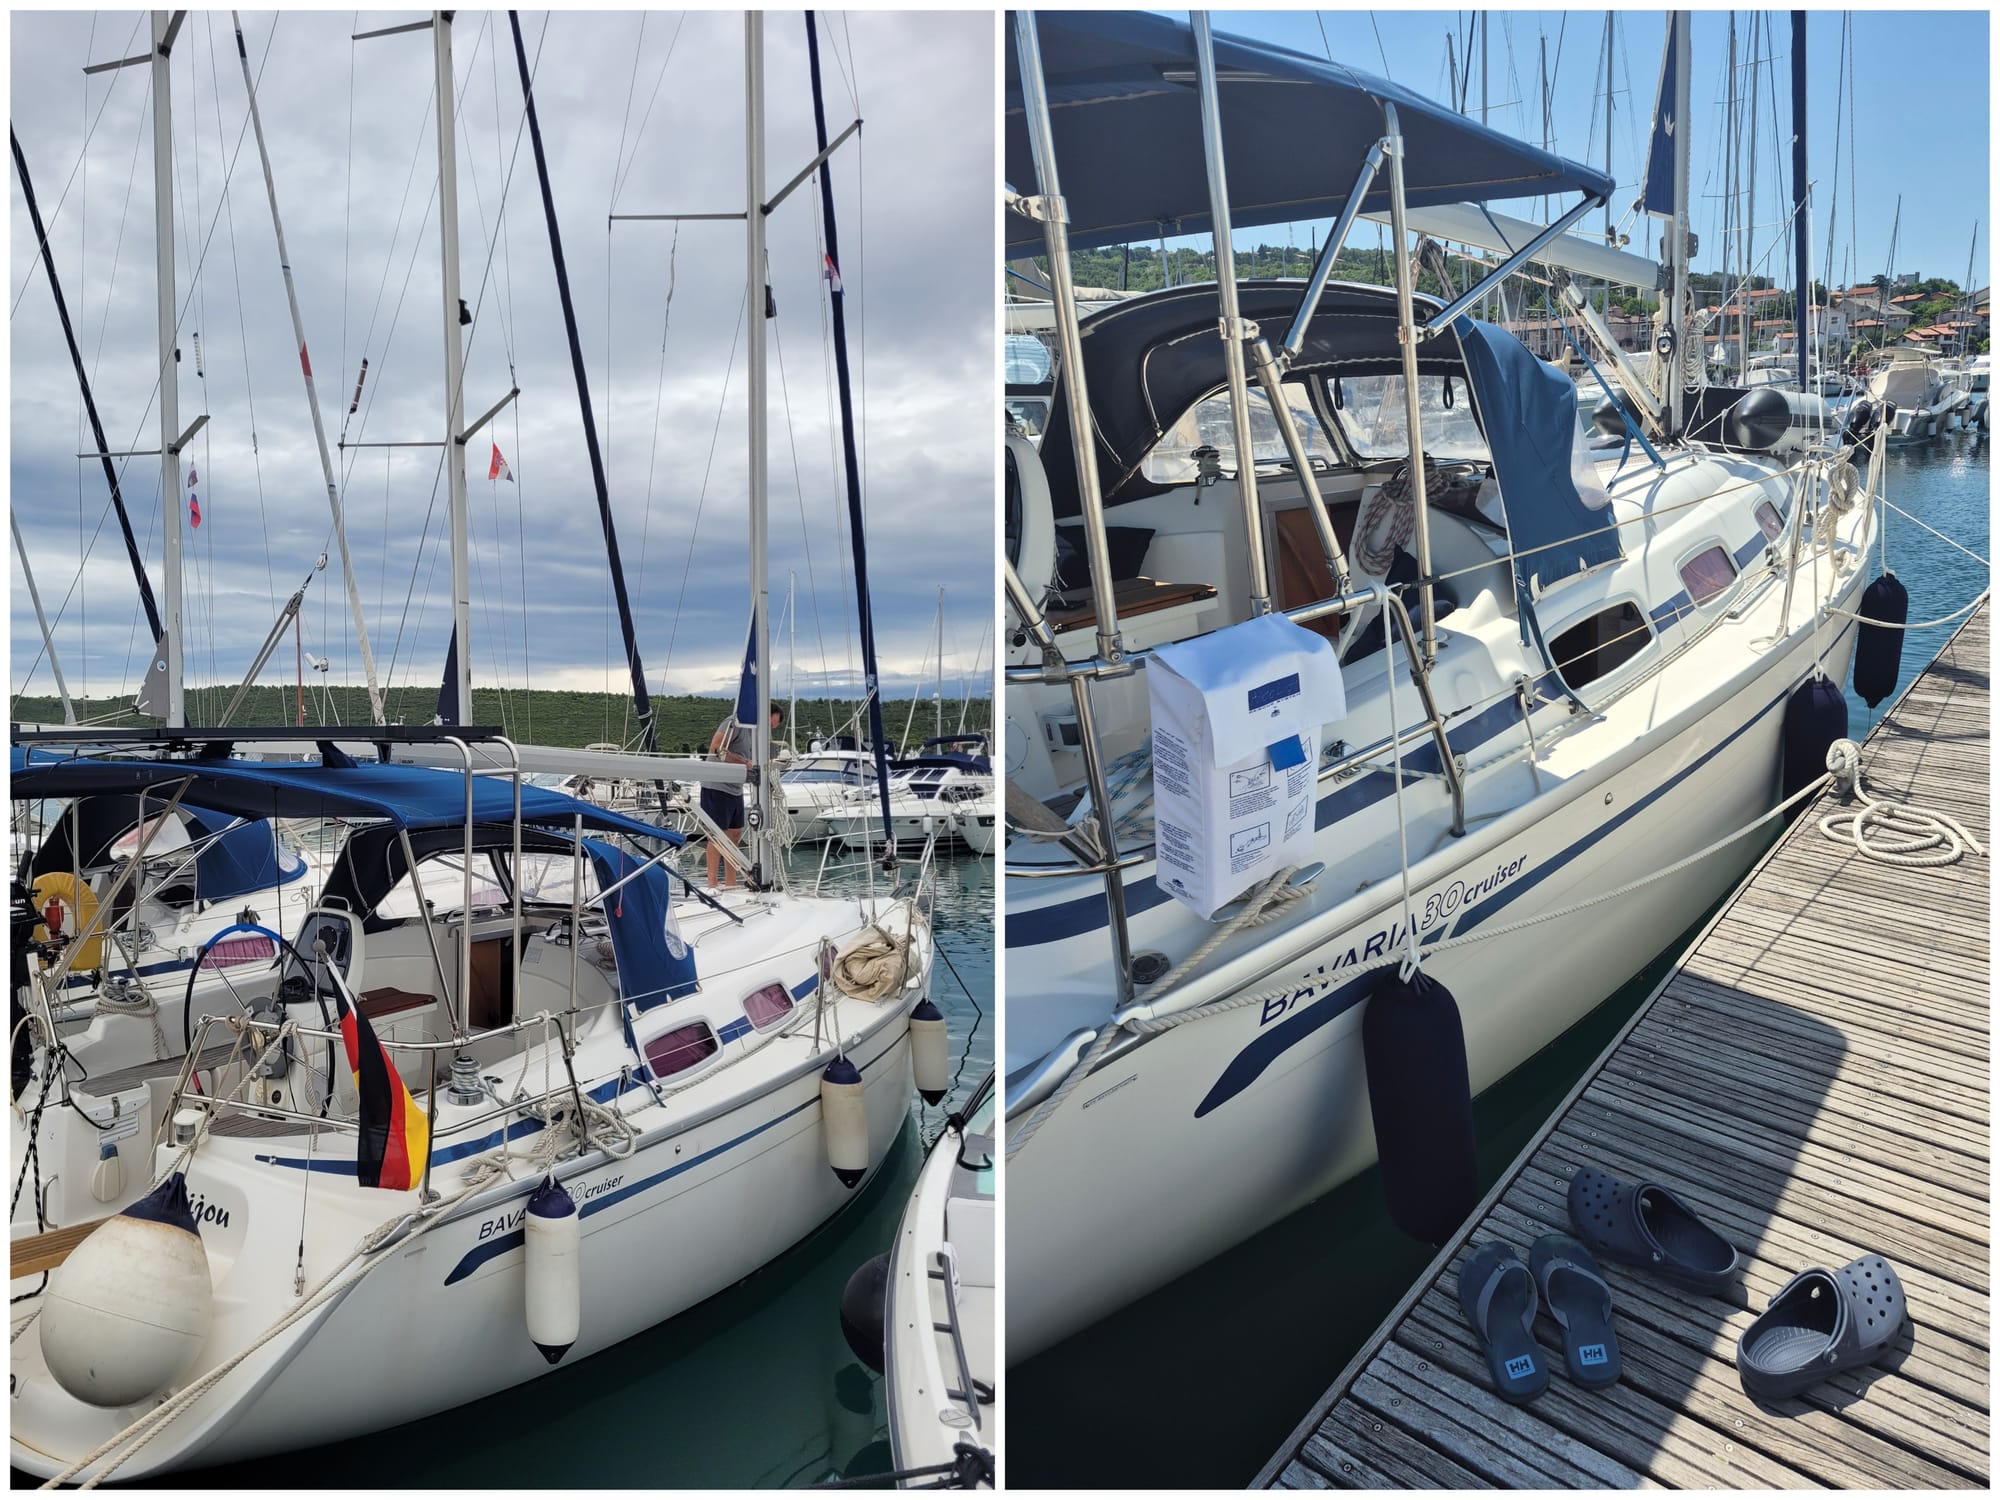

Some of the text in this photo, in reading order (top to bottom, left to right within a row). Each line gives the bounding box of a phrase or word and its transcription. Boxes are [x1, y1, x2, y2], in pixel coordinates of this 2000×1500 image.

[1421, 881, 1464, 930] 30
[1463, 854, 1527, 904] cruiser
[188, 1192, 230, 1229] ijou
[478, 1207, 526, 1241] BAVA
[585, 1174, 624, 1199] cruiser
[1509, 1359, 1530, 1372] HH
[1583, 1348, 1603, 1359] HH
